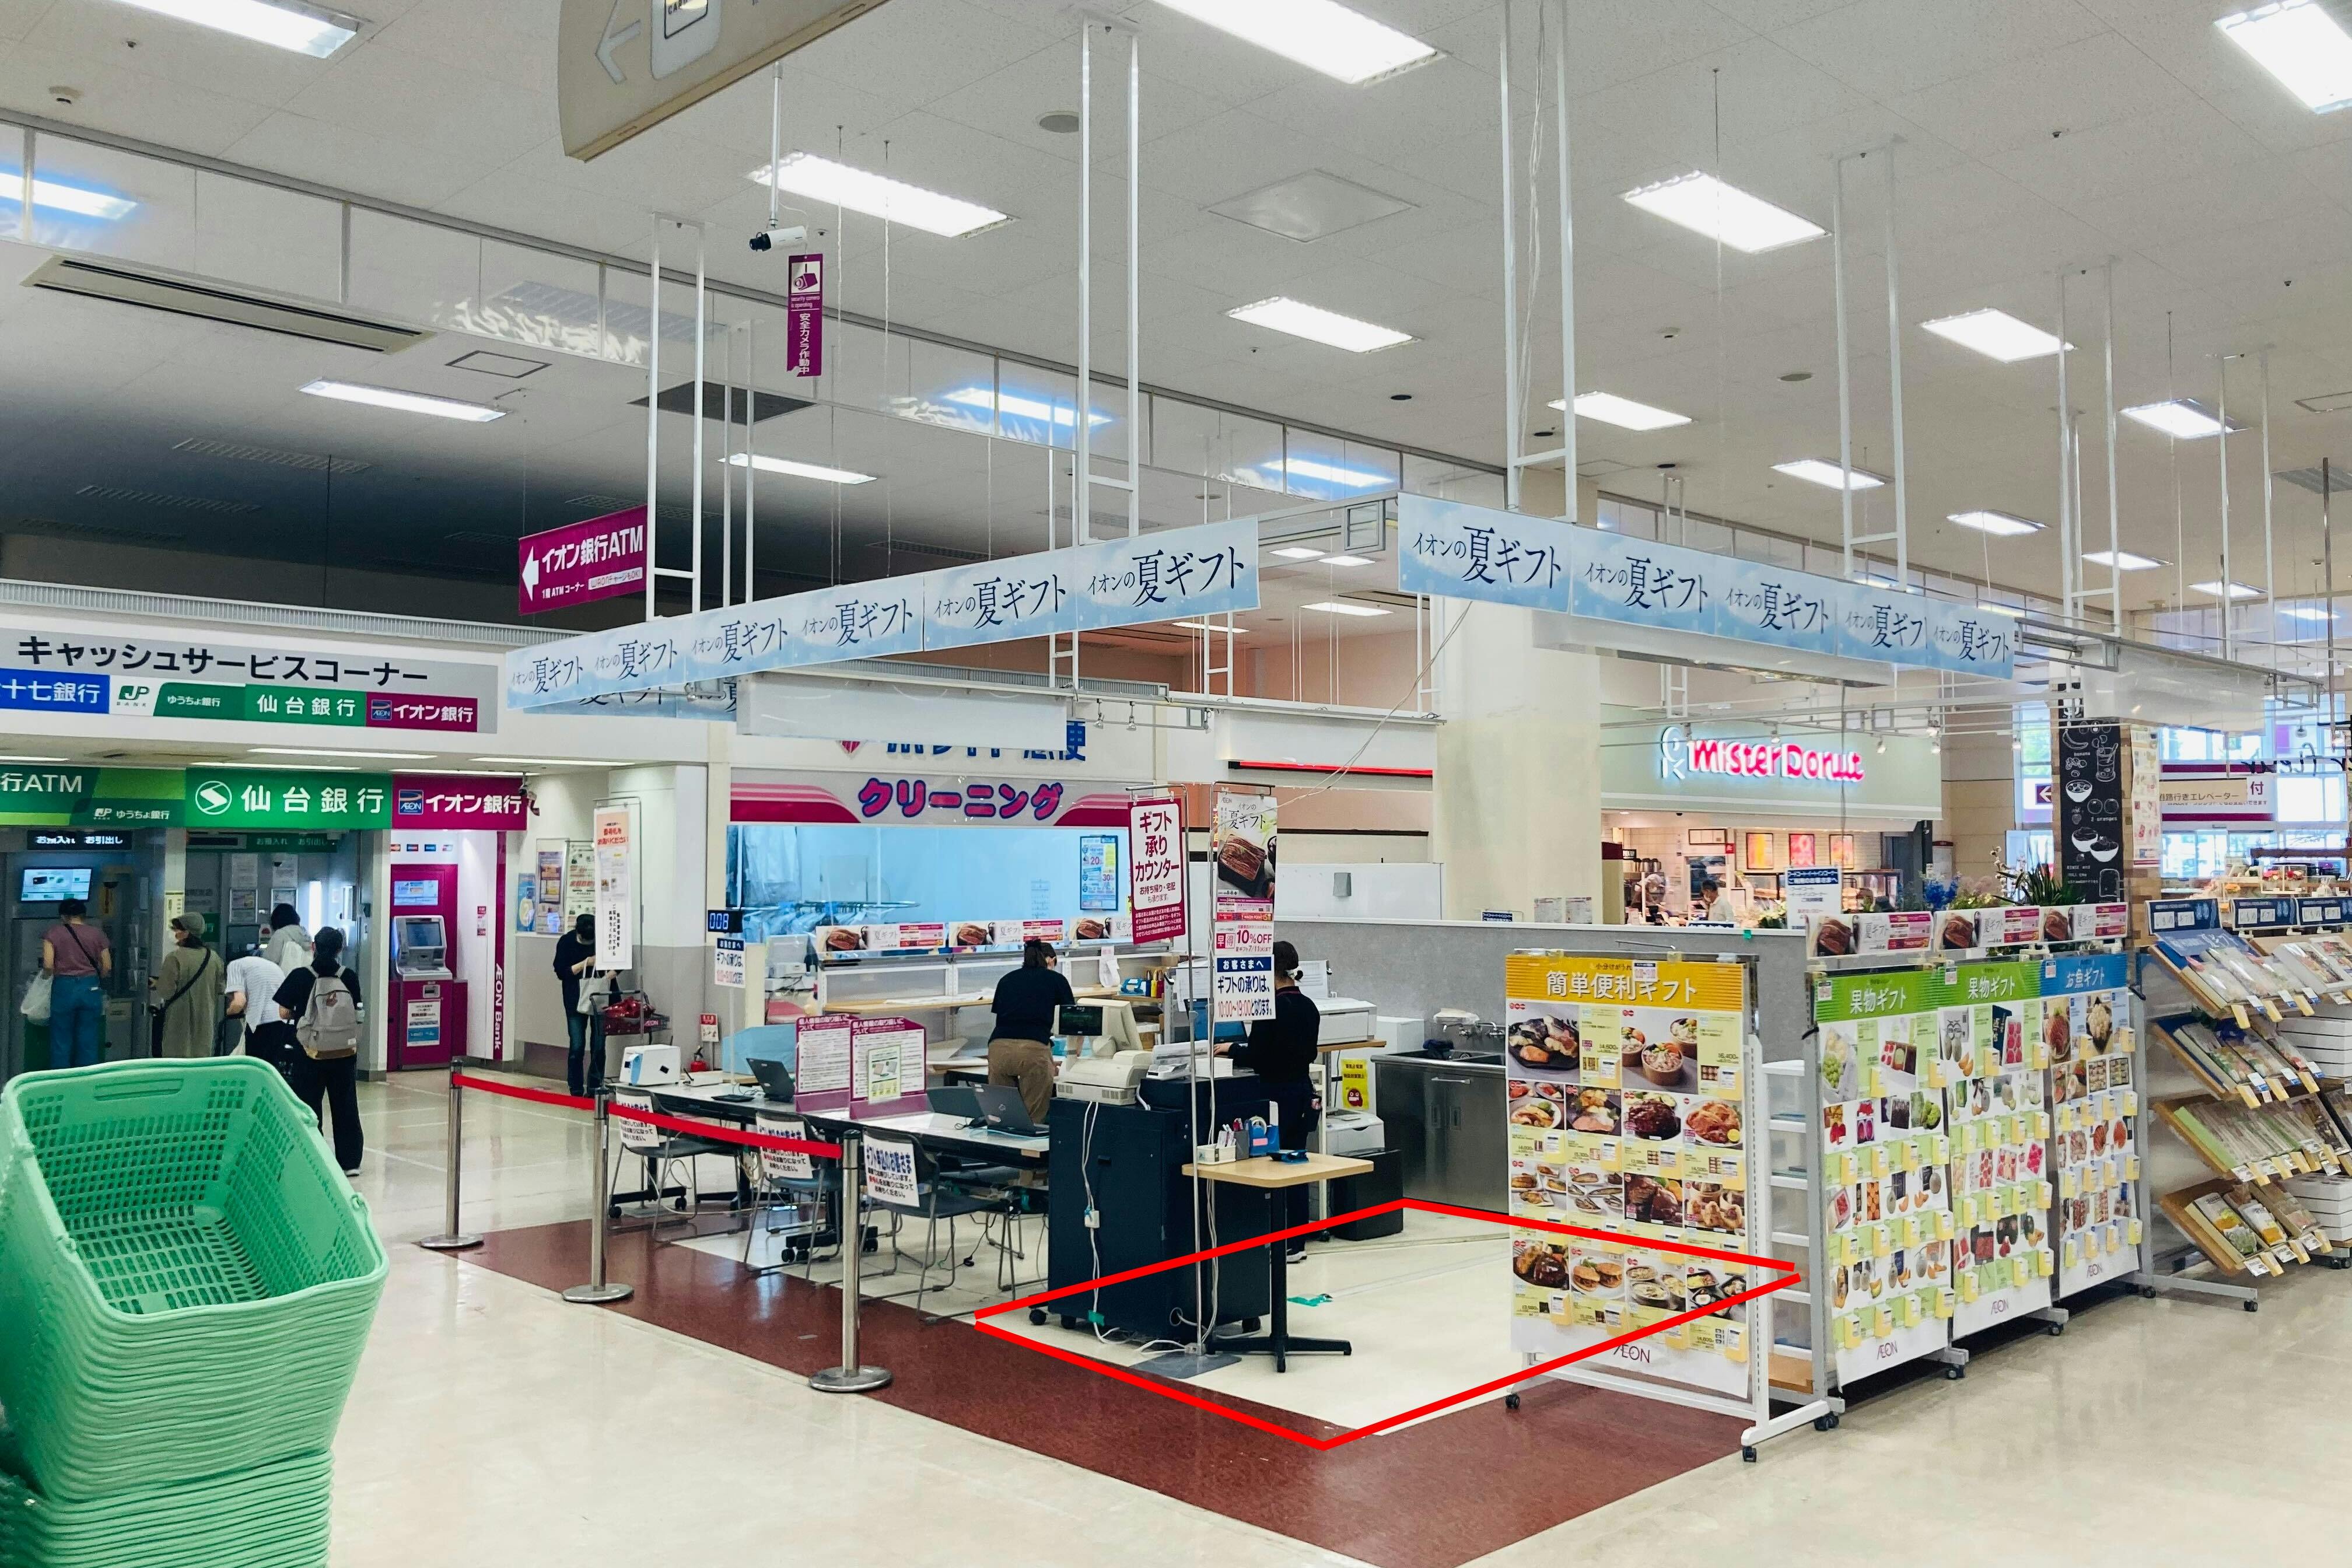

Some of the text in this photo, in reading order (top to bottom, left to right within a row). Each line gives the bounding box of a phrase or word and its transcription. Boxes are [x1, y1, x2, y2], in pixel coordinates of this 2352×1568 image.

[799, 313, 810, 374] 安全カメラ作動中
[542, 525, 643, 573] イオン銀行ATM
[1412, 526, 1562, 589] イオンの夏ギフト
[1087, 546, 1245, 607] イオンの夏ギフト
[1585, 556, 1708, 613] イオンの夏ギフト
[935, 575, 1066, 629] イオンの夏ギフト
[1726, 583, 1829, 634] イオンの夏ギフト
[802, 598, 913, 647] イオンの夏ギフト
[691, 618, 788, 664] イオンの夏ギフト
[1934, 620, 2009, 663] イオンの夏ギフト
[18, 636, 428, 686] キャッシュサービスコーナー
[595, 639, 678, 680] イオンの夏ギフト
[511, 655, 583, 695] イオンの夏ギフト
[0, 678, 100, 704] 十七銀行
[167, 695, 220, 707] ゆうちょ銀行
[257, 694, 356, 716] 仙台銀行
[394, 704, 474, 723] イオン銀行
[1, 773, 82, 793] 行ATM
[241, 785, 384, 813] 仙台銀行
[426, 794, 522, 814] イオン銀行
[859, 778, 1063, 820] クリーニング
[116, 810, 170, 820] ゆうちょ銀行
[1139, 811, 1172, 832] ギフト
[1228, 810, 1265, 829] 夏ギフト
[1145, 835, 1167, 857] 承り
[1135, 859, 1179, 883] カウンター
[1140, 882, 1175, 894] お持ち帰り・宅配
[709, 913, 729, 929] 008
[1115, 921, 1132, 932] 夏ギフ
[1223, 960, 1264, 969] お客さまへ
[1596, 963, 1632, 971] 小分けがうれ
[1217, 975, 1270, 994] ギフトの承りは、
[1546, 970, 1697, 1003] 簡単便利ギフト
[1968, 975, 2015, 1000] 果物ギフト
[1850, 986, 1907, 1014] 果物ギフト
